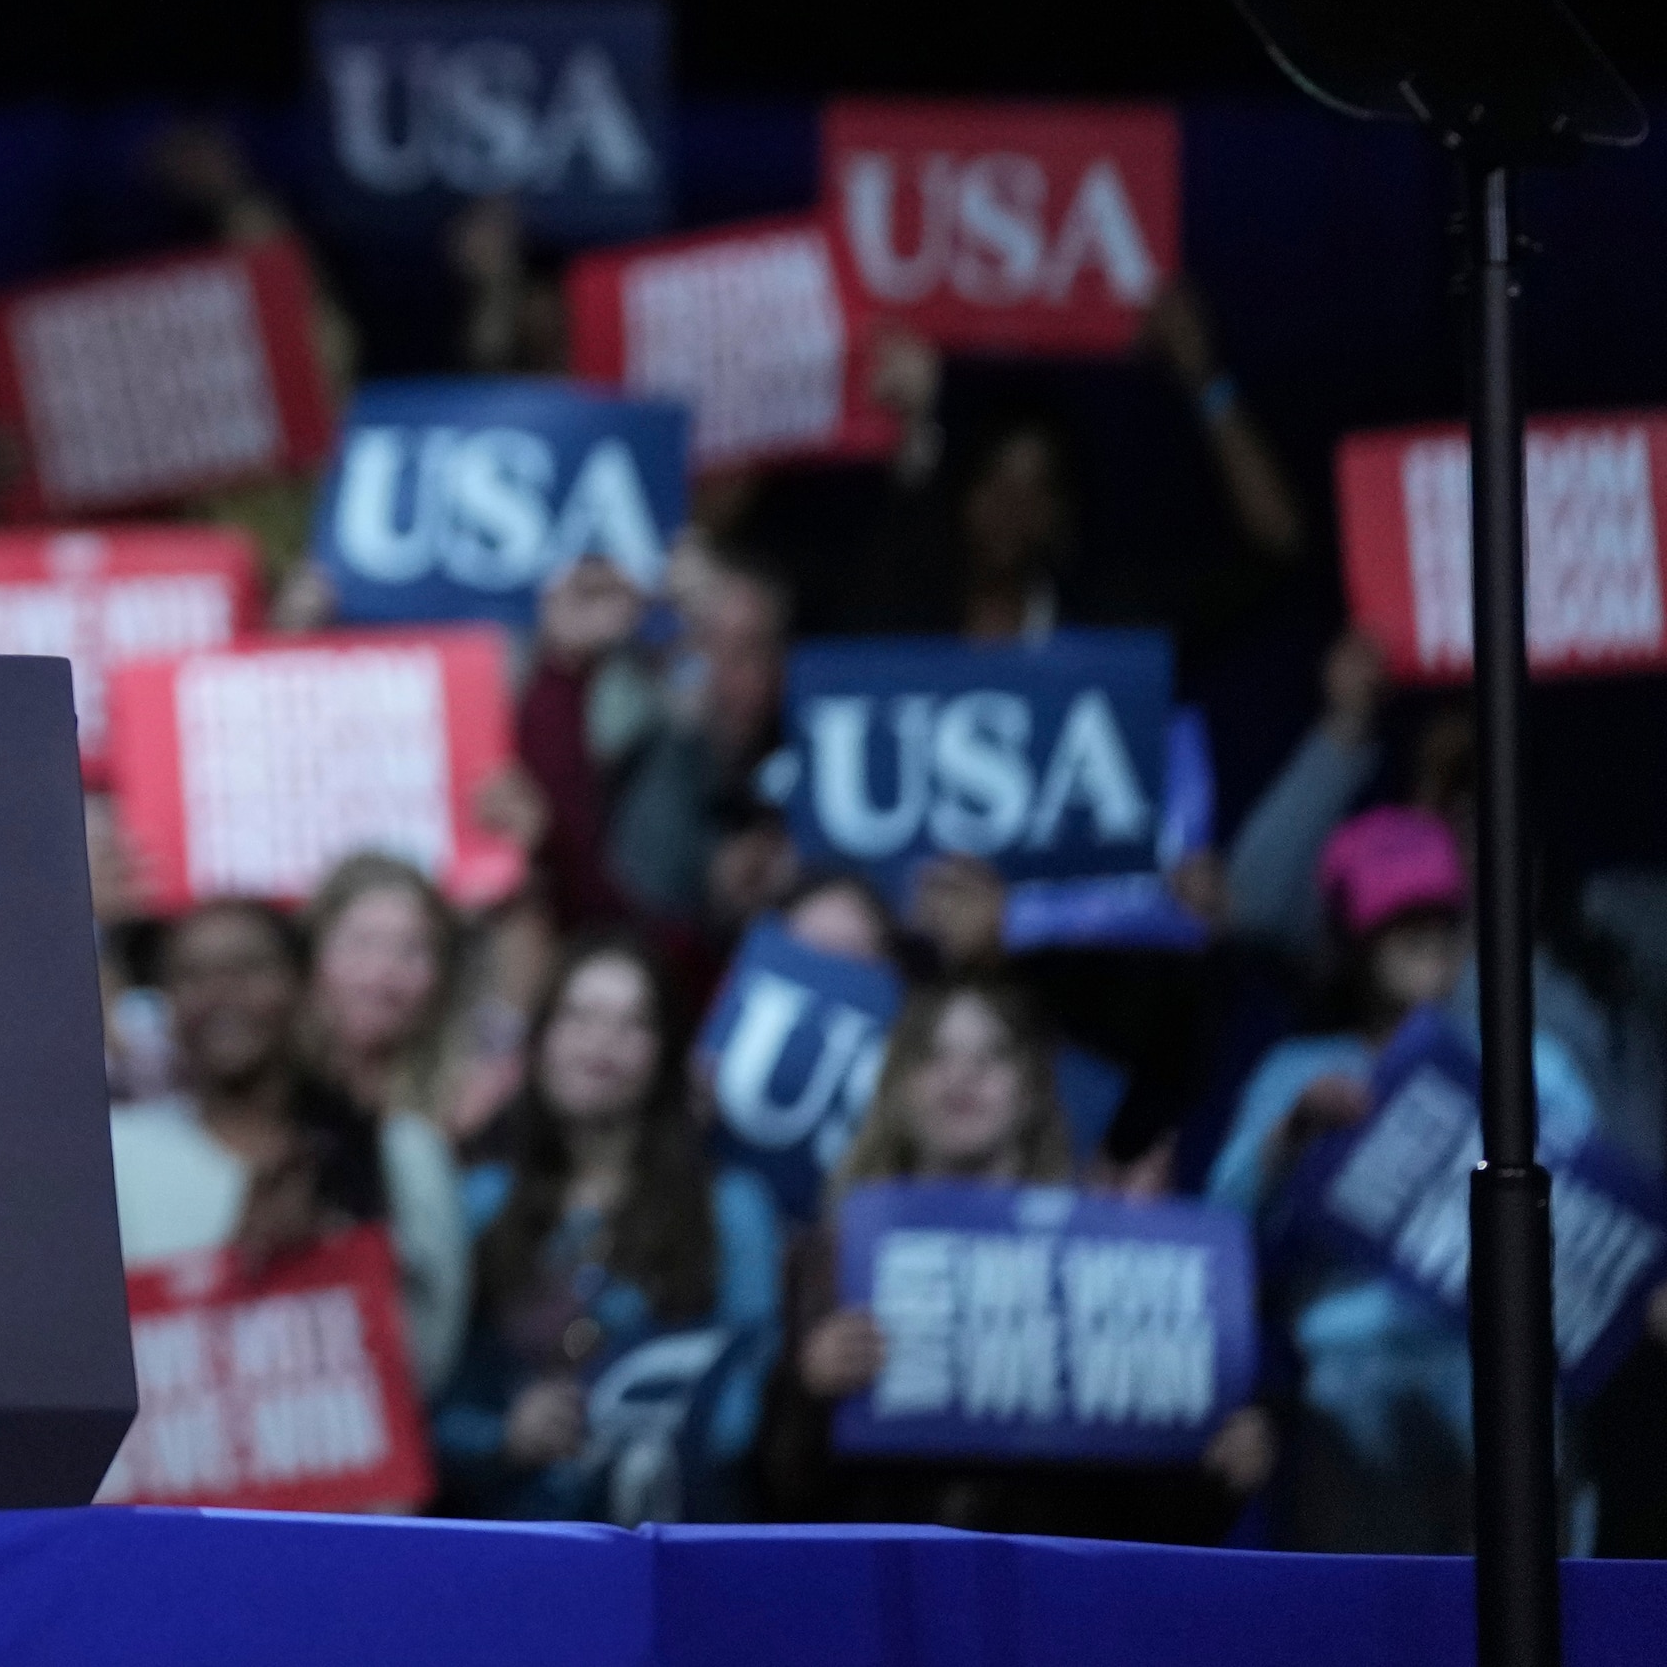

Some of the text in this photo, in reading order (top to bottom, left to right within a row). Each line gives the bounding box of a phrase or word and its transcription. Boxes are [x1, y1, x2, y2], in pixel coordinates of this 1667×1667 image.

[325, 39, 661, 197] USA
[839, 149, 1161, 307] USA
[331, 423, 669, 593] USA
[807, 687, 1153, 859] USA
